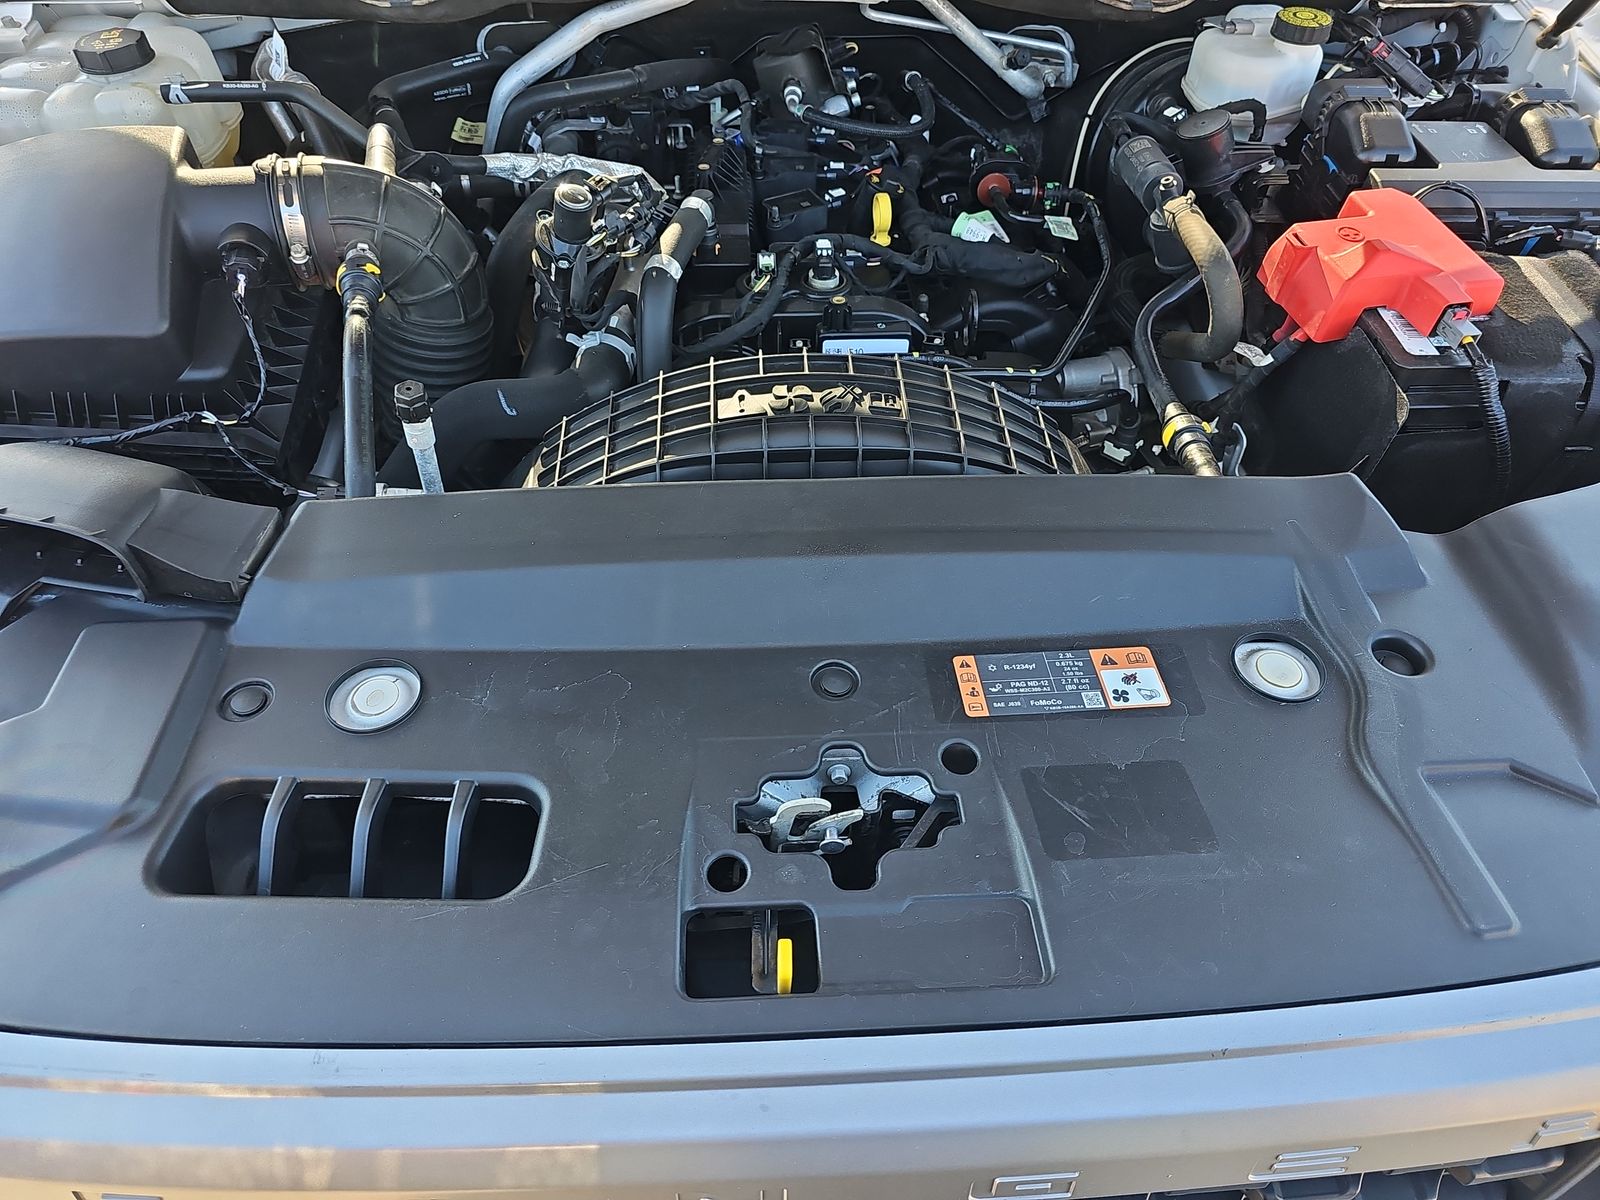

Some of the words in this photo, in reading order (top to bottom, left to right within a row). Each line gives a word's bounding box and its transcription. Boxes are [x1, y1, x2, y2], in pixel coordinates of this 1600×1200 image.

[1004, 663, 1036, 671] R-1234yf
[1010, 680, 1026, 688] PAG
[1027, 679, 1049, 687] ND-12
